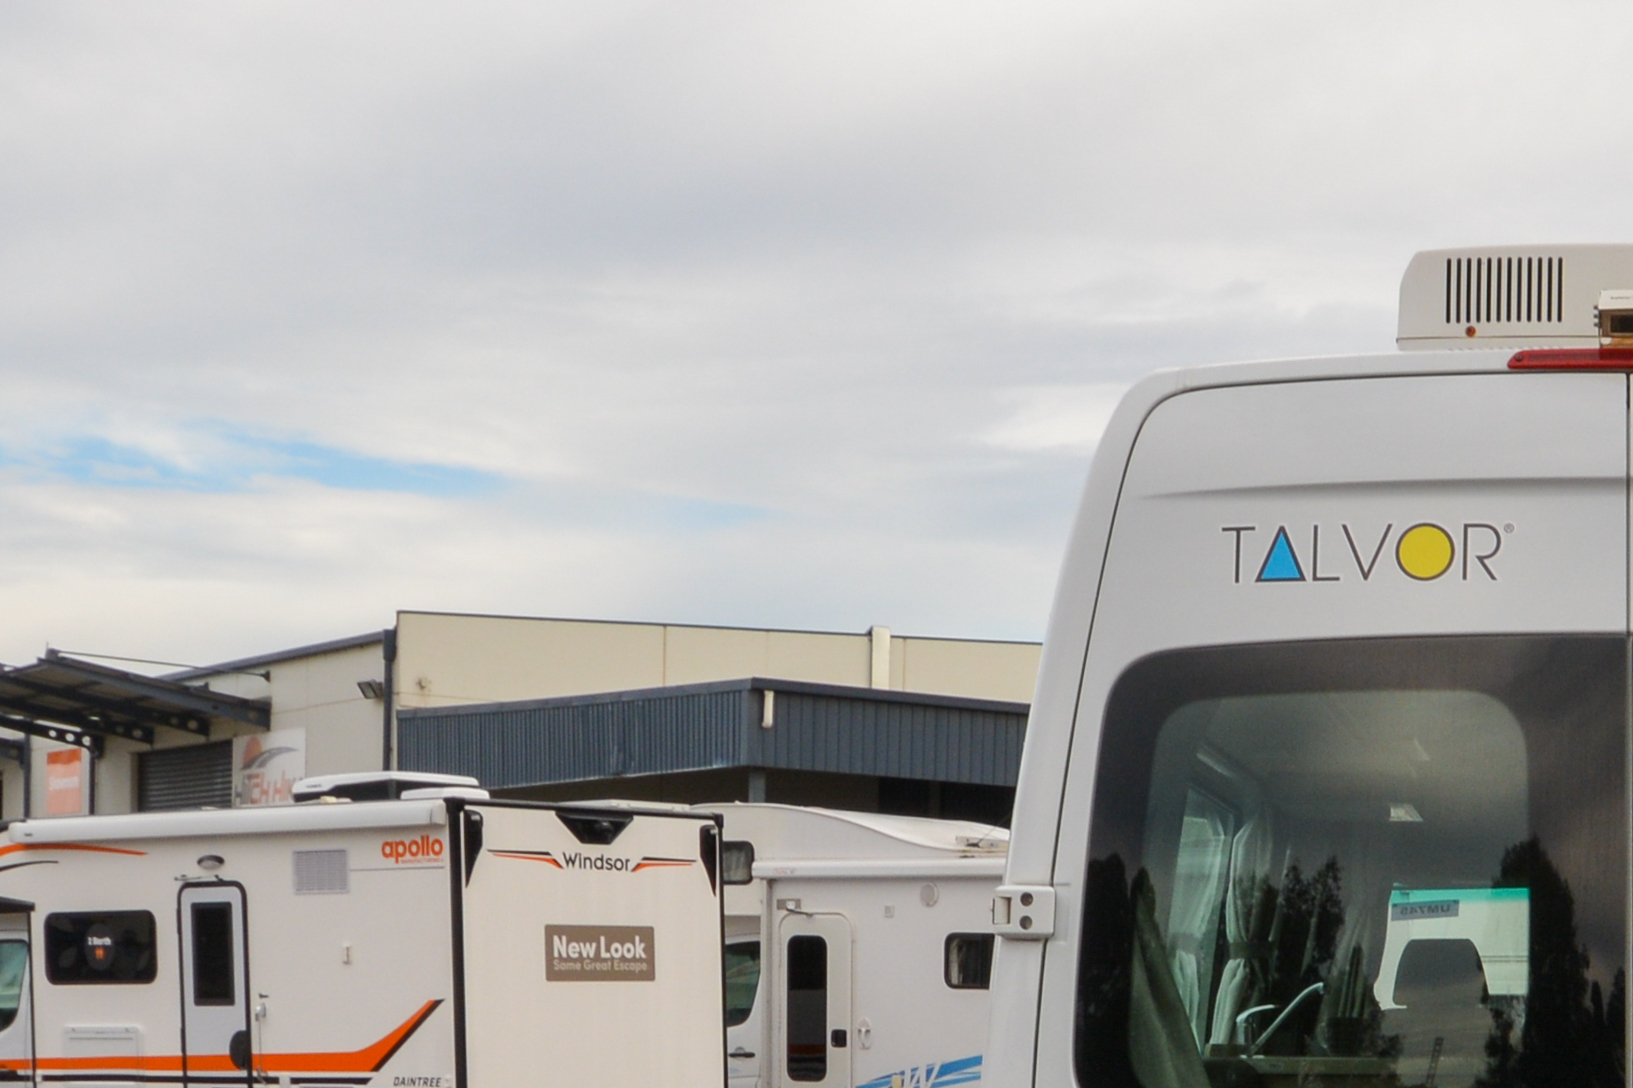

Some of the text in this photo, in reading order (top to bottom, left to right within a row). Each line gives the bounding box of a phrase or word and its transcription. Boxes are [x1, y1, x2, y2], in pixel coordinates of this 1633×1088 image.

[381, 833, 444, 864] apollo
[562, 851, 631, 872] Windsor
[552, 934, 647, 959] New Look
[553, 959, 648, 974] Same Great Escape
[393, 1076, 442, 1088] DAINTREE
